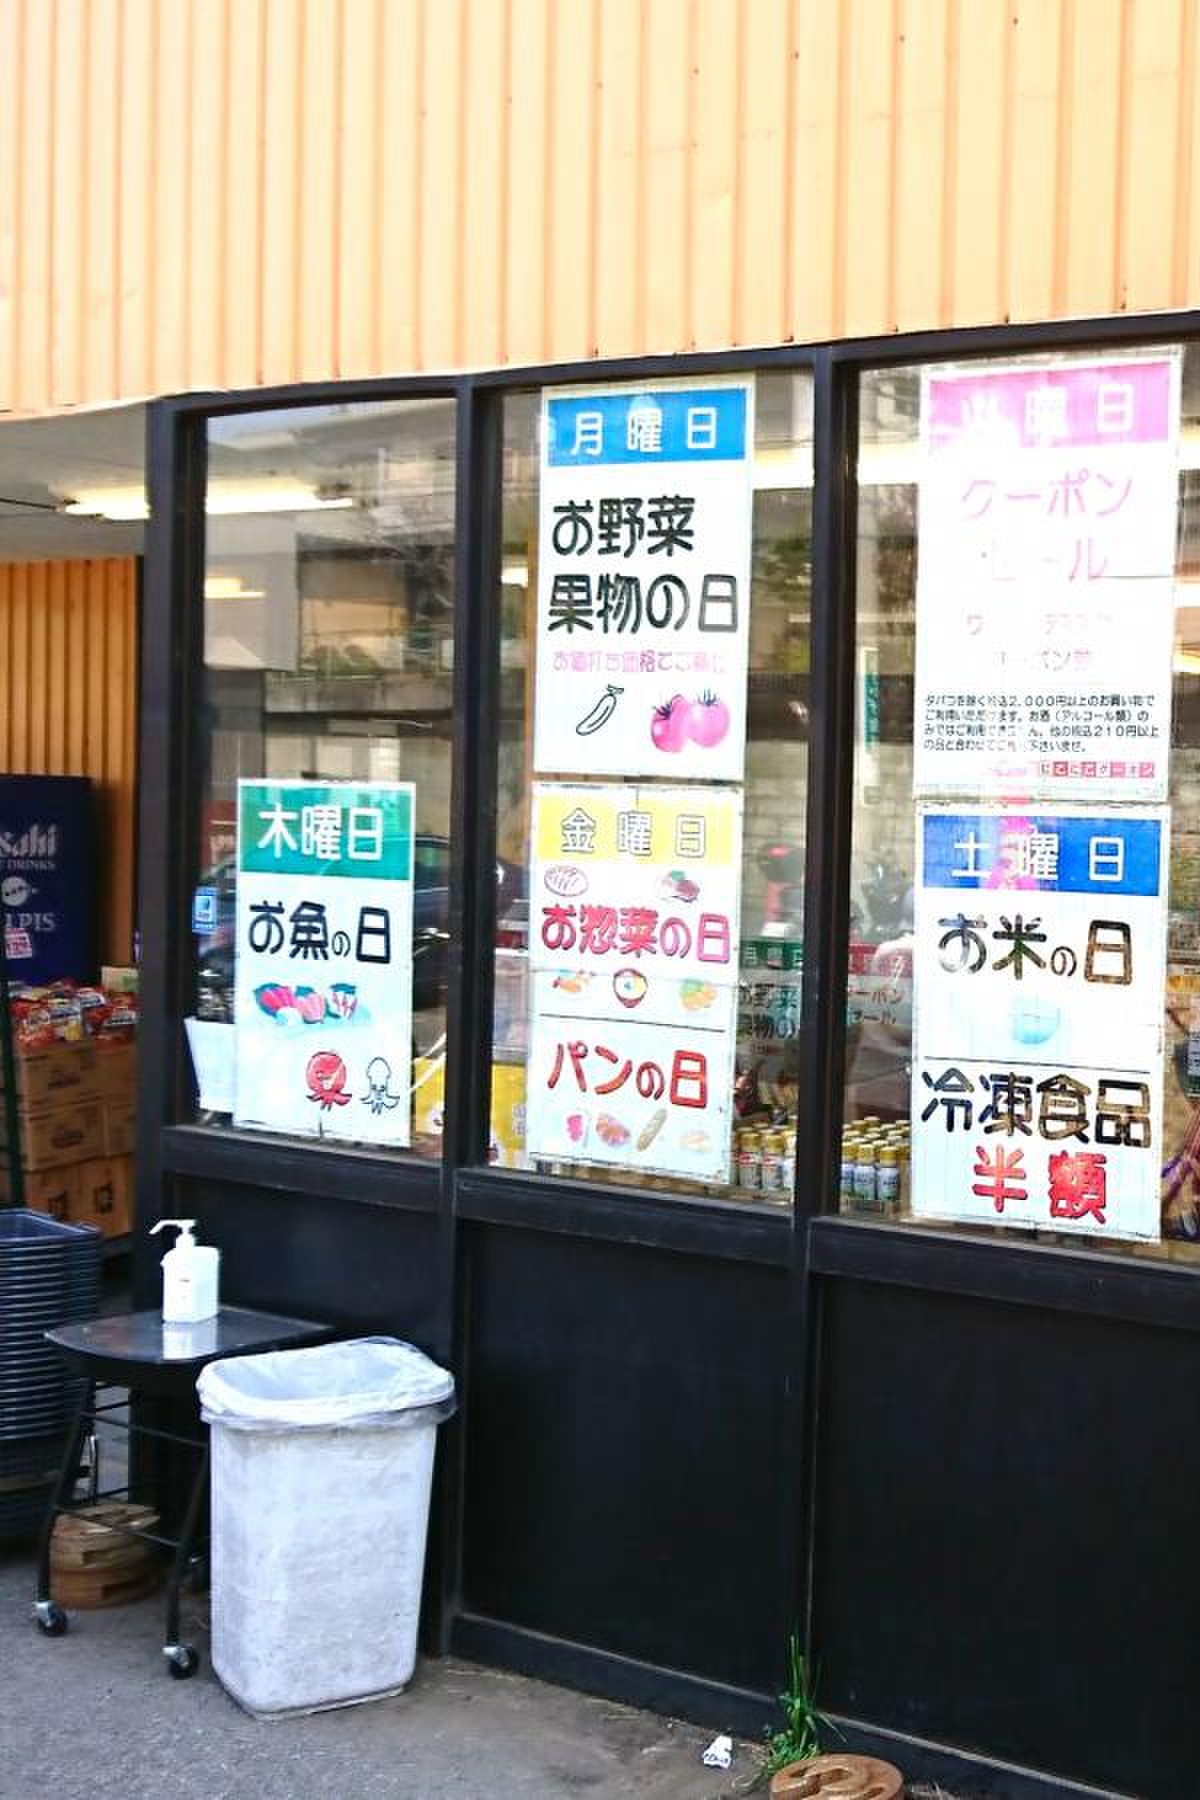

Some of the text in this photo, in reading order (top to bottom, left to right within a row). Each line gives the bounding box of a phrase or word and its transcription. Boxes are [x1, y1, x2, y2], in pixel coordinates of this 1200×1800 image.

[570, 406, 718, 458] 月曜日
[551, 494, 696, 558] お野菜
[960, 467, 1133, 523] クーポン
[547, 572, 739, 635] 果物の日
[257, 803, 384, 861] 木曜日
[559, 806, 708, 858] 金曜日
[951, 829, 1126, 883] 土曜日
[248, 900, 392, 965] お魚の日
[541, 903, 732, 964] お惣菜の日
[937, 912, 1134, 986] お米の日
[547, 1039, 710, 1110] パンの日
[921, 1067, 1152, 1149] 冷凍食品
[971, 1144, 1108, 1225] 半額
